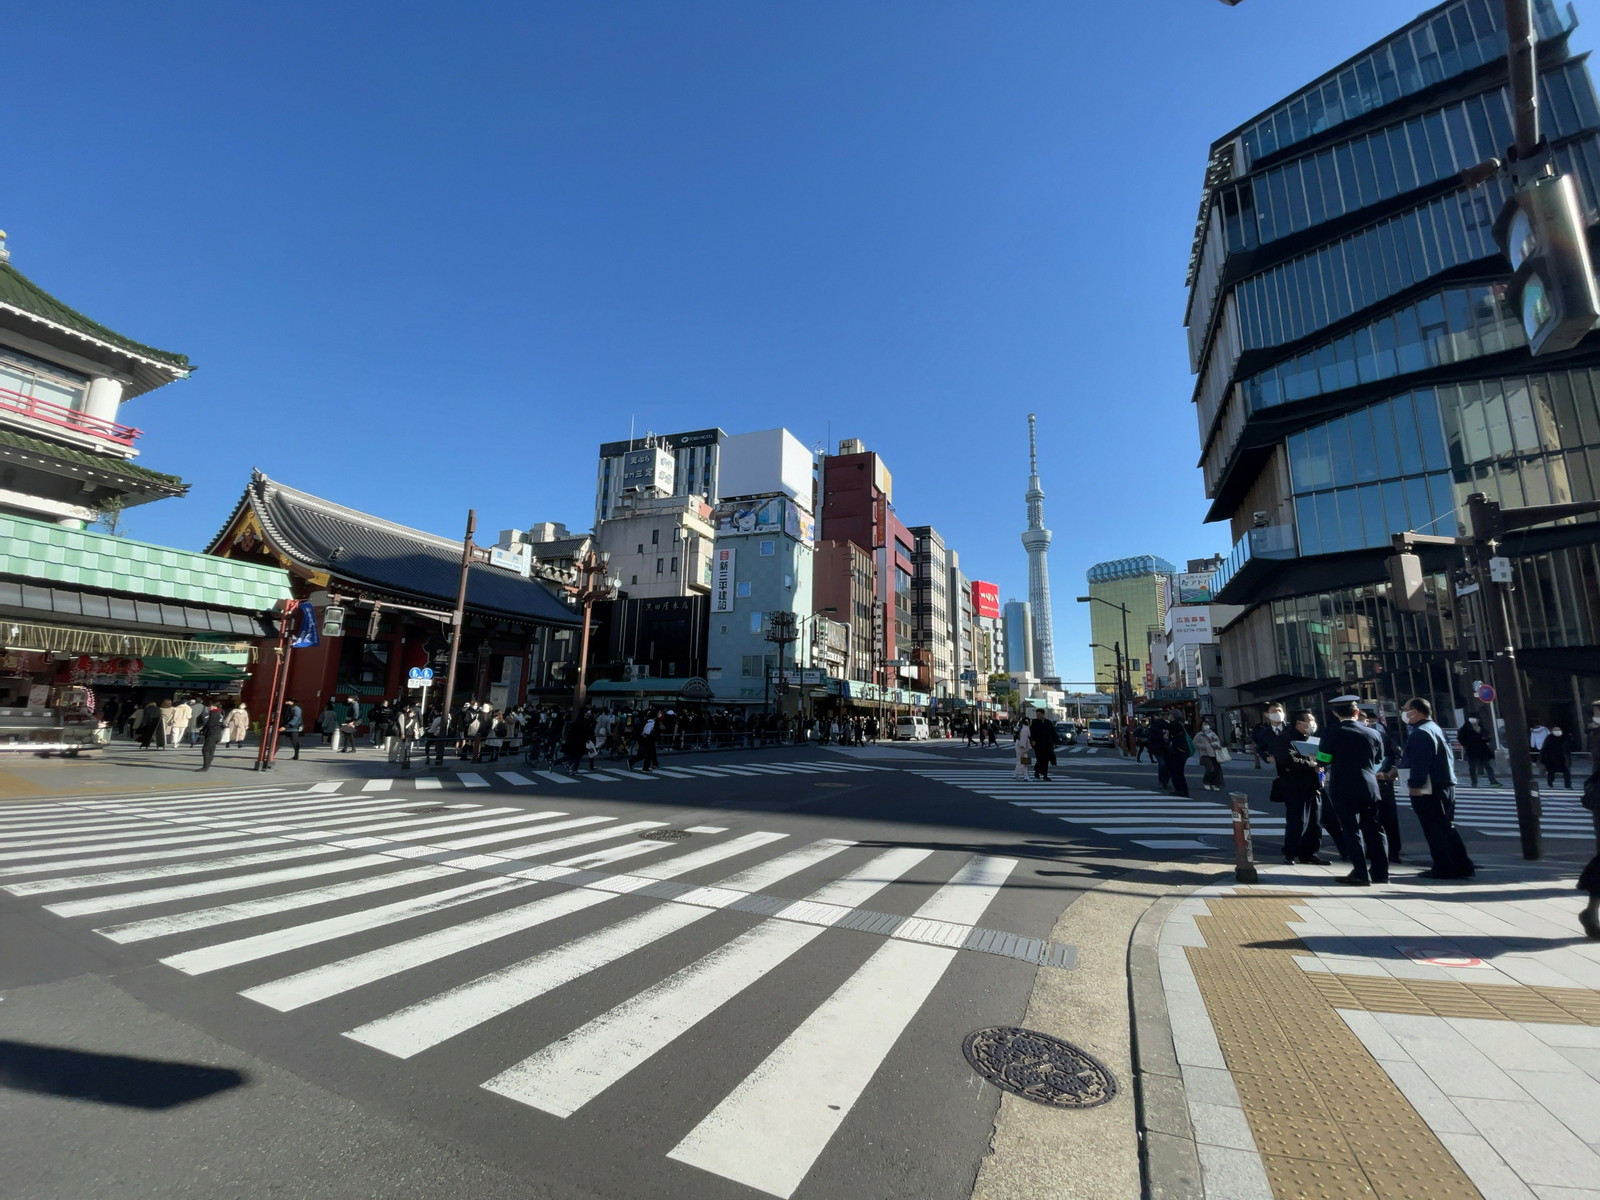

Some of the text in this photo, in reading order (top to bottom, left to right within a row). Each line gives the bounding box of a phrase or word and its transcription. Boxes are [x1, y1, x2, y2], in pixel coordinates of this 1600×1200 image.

[717, 561, 729, 610] 新三平建設
[646, 601, 689, 611] 黒田屋本店
